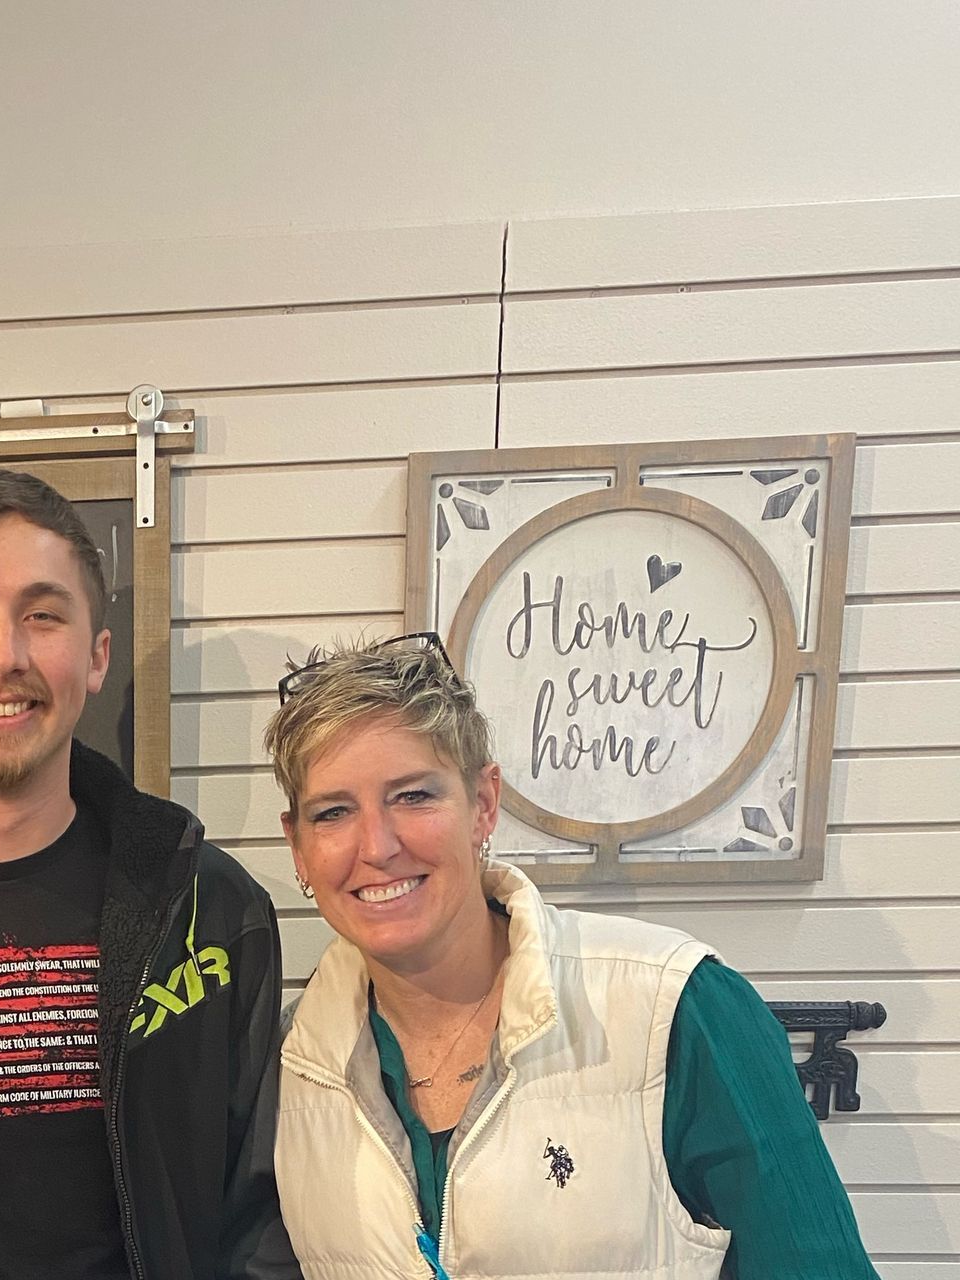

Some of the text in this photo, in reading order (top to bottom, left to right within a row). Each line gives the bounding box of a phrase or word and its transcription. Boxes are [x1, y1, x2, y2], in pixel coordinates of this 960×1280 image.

[506, 571, 757, 658] Home
[566, 638, 723, 730] sweet
[531, 679, 676, 779] home
[35, 959, 63, 971] SWEAR,
[62, 959, 80, 969] THAT
[12, 988, 25, 997] THE
[25, 984, 73, 996] CONSTITUTION
[72, 984, 82, 993] OF
[82, 984, 94, 992] THE
[18, 1012, 32, 1022] ALL
[32, 1010, 67, 1021] ENEMIES,
[66, 1009, 99, 1020] FOREIGN
[13, 1039, 24, 1050] TO
[24, 1037, 40, 1048] THE
[66, 1035, 73, 1045] &
[73, 1034, 93, 1045] THAT
[4, 1064, 17, 1074] THE
[17, 1063, 43, 1074] ORDERS
[43, 1063, 51, 1072] OF
[51, 1062, 64, 1072] THE
[64, 1061, 95, 1071] OFFICERS
[10, 1091, 29, 1102] CODE
[30, 1090, 39, 1101] OF
[40, 1089, 73, 1100] MILITARY
[73, 1088, 102, 1098] JUSTICE
